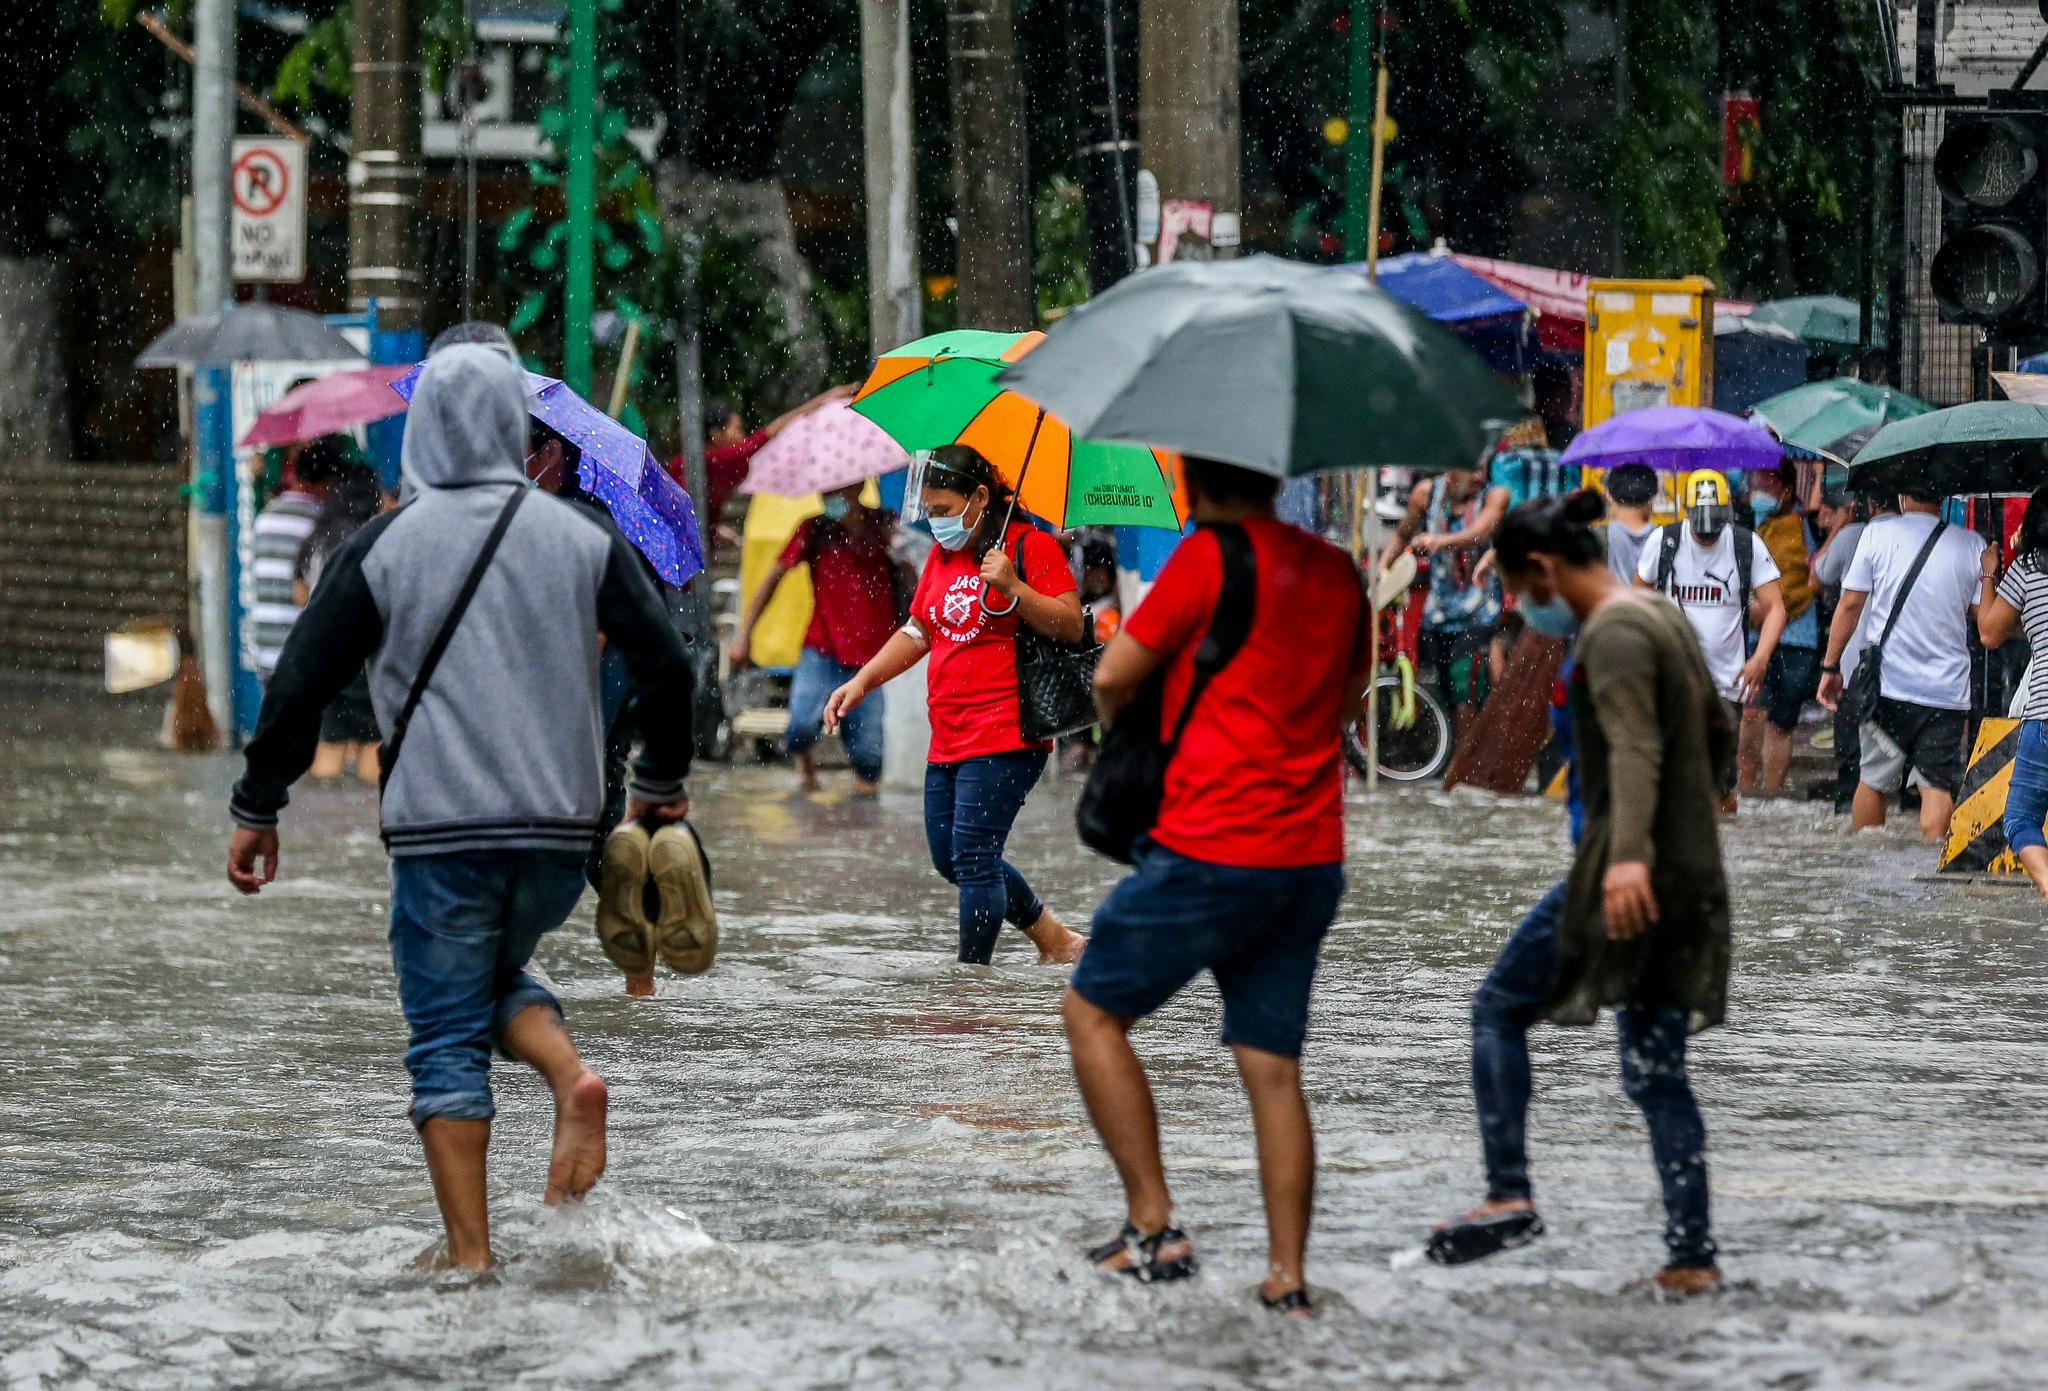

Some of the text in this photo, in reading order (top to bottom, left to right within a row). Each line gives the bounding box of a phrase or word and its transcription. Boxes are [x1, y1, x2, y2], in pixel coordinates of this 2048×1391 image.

[948, 575, 980, 591] JAG
[1672, 585, 1722, 601] PUMA
[951, 627, 980, 641] STATES
